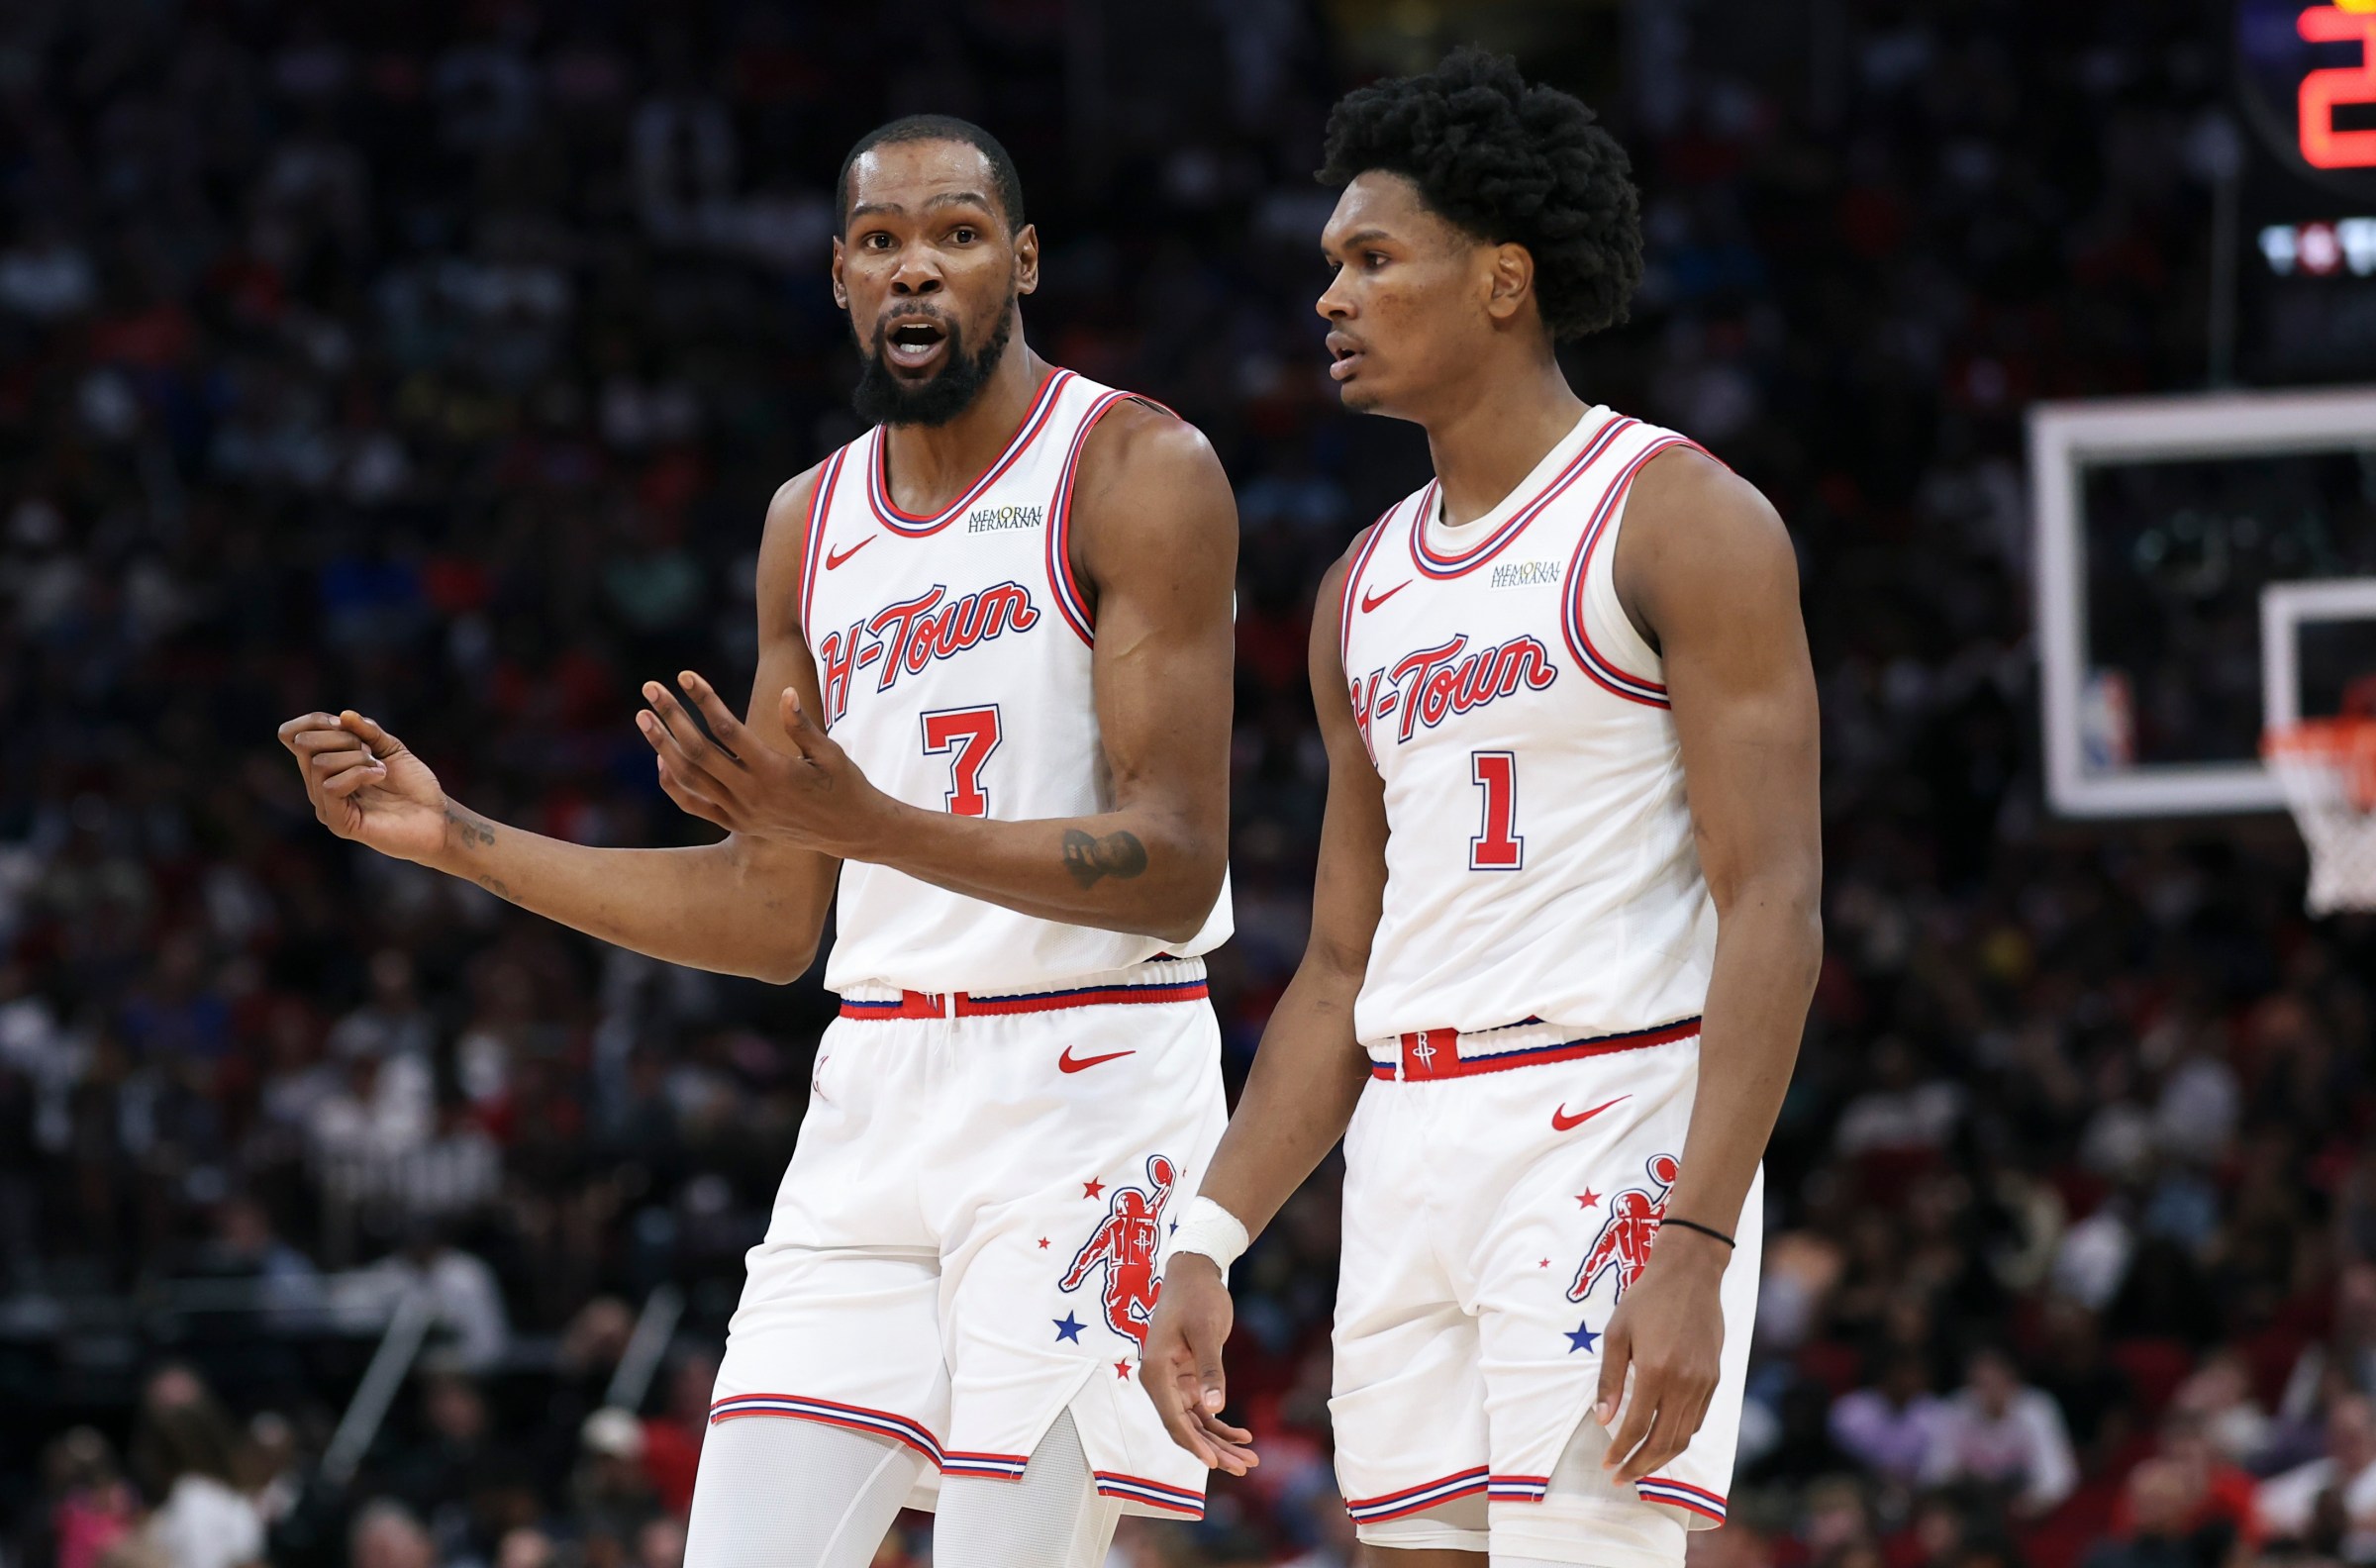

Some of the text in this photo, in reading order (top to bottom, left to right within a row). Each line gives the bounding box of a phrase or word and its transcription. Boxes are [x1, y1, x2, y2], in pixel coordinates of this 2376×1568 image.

[968, 515, 1041, 534] HERMANN
[969, 506, 1042, 523] MEMORIAL
[1491, 571, 1559, 588] HERMANN
[1493, 561, 1561, 577] MEMORIAL
[820, 580, 1040, 736] H-Town
[1350, 634, 1558, 769] H-Town
[920, 704, 1003, 819] 7
[1469, 751, 1525, 871] 1
